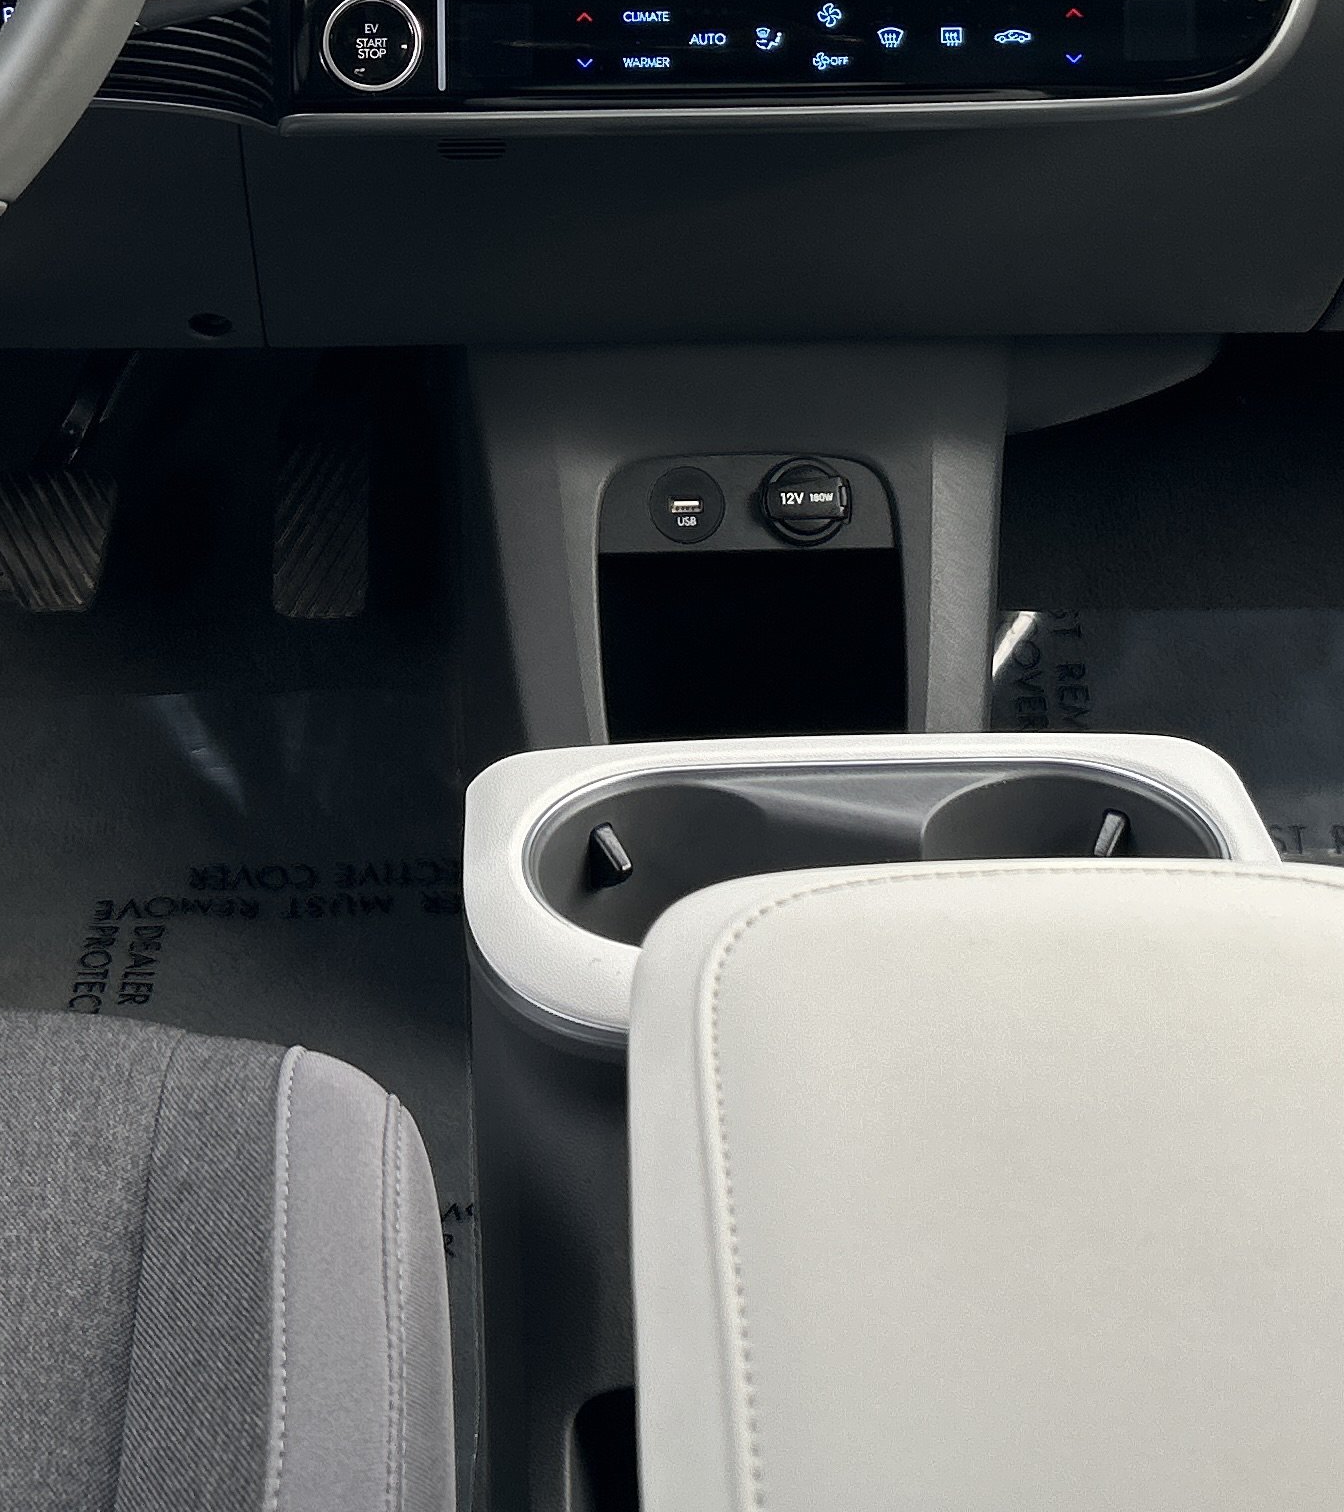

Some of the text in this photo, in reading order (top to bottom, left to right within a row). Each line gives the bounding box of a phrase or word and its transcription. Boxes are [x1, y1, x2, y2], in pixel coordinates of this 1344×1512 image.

[622, 10, 671, 22] CLIMATE
[364, 23, 379, 34] EV
[356, 37, 388, 49] START
[689, 33, 726, 45] AUTO
[357, 48, 387, 59] STOP
[622, 56, 671, 68] WARMER
[830, 56, 849, 66] OFF
[780, 492, 804, 505] 12V
[677, 516, 697, 527] USB
[188, 862, 319, 890] COVER
[115, 925, 167, 1007] DEALER
